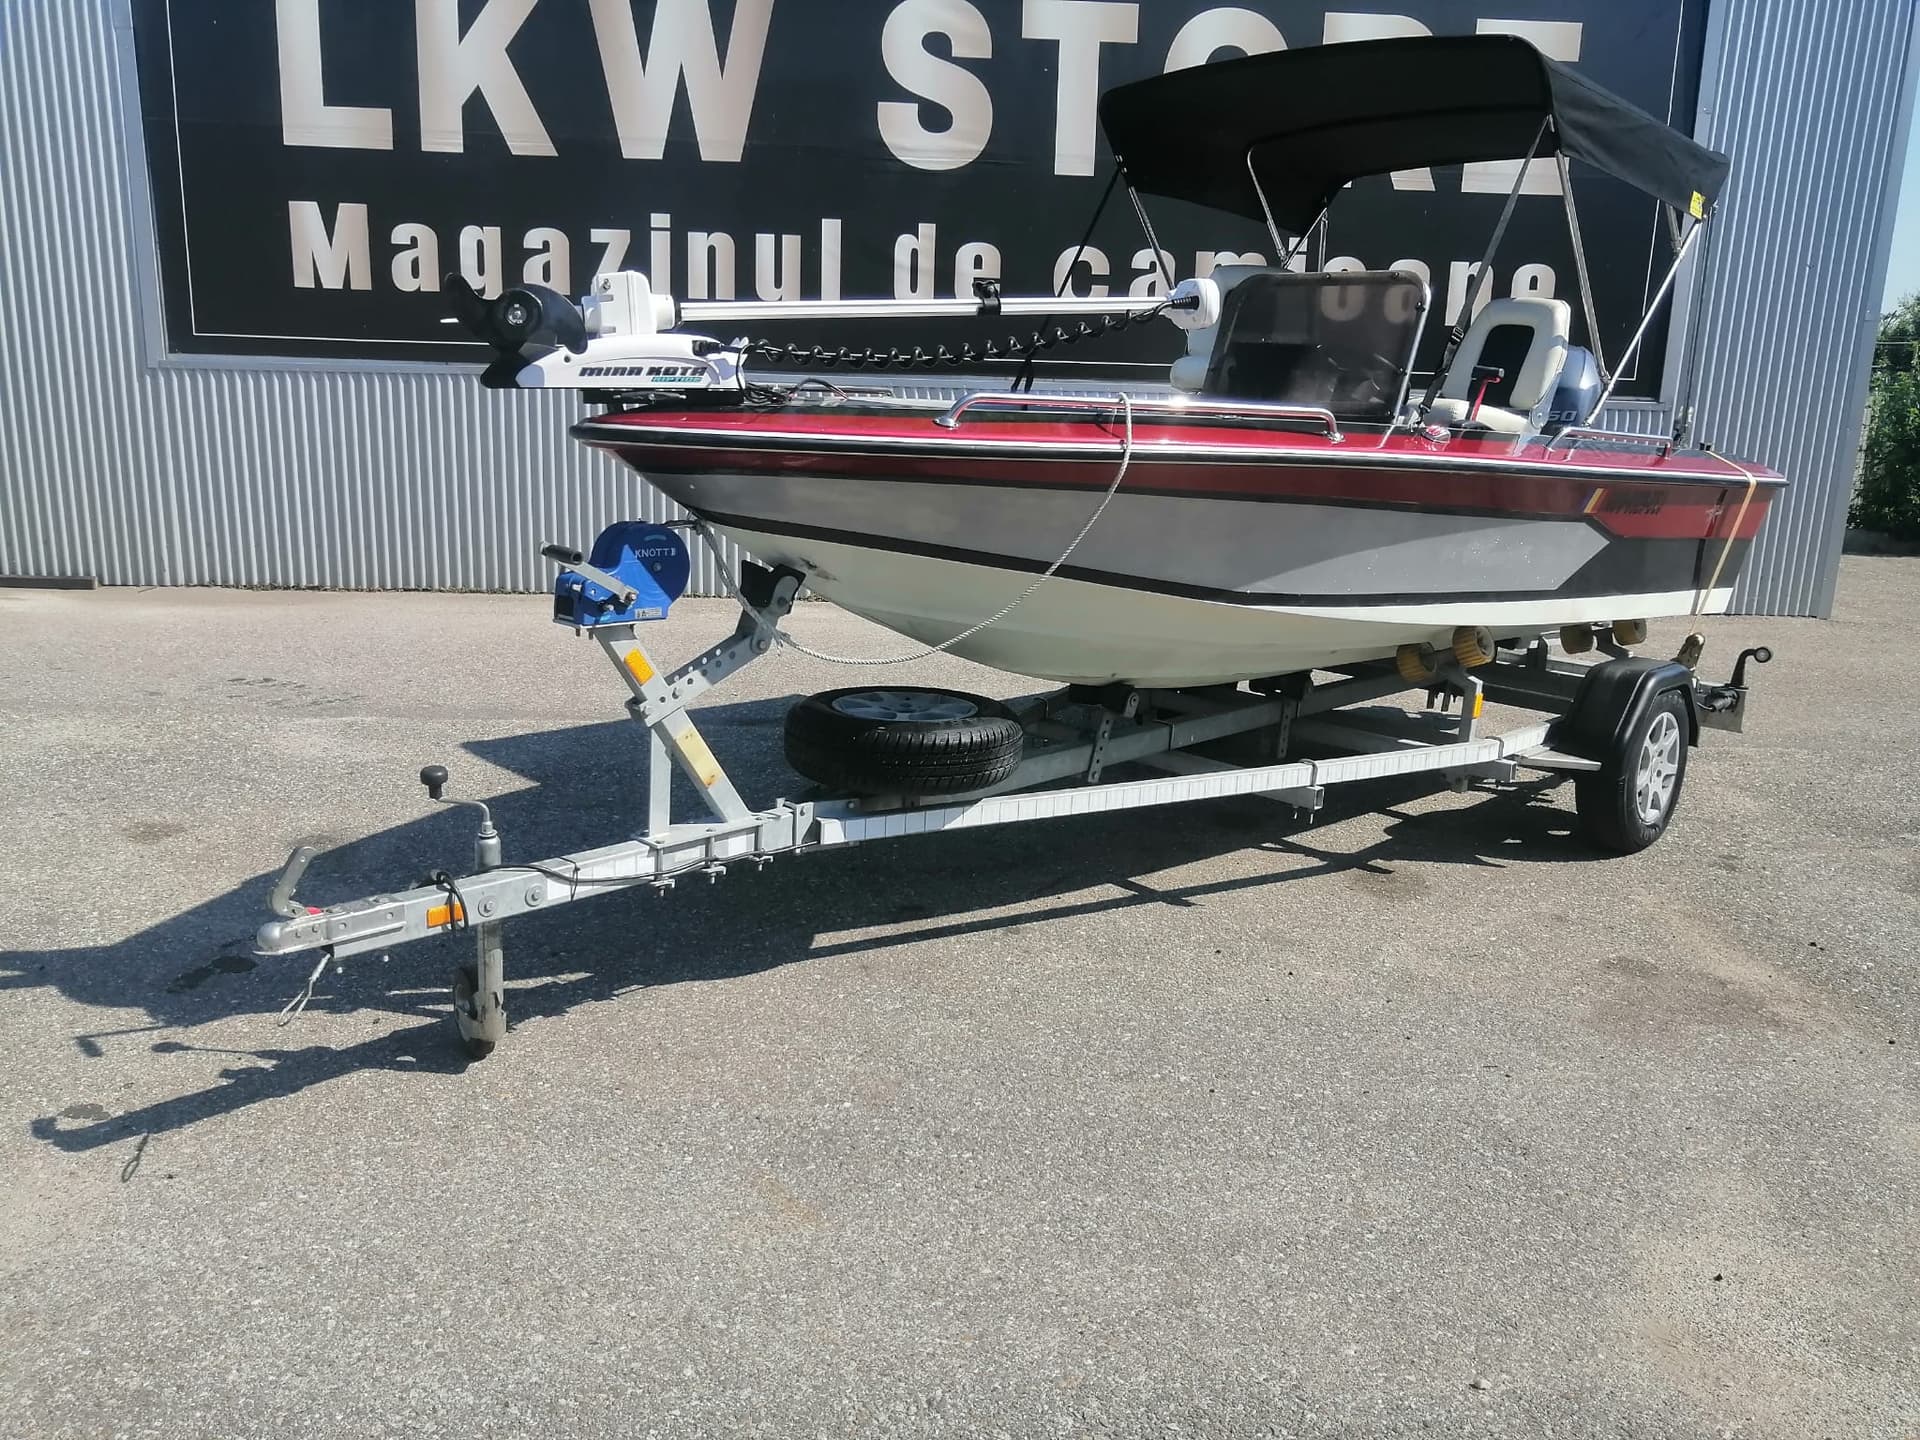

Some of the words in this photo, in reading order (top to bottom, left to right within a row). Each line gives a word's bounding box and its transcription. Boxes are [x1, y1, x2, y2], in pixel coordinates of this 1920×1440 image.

[276, 0, 773, 162] LKW
[288, 200, 842, 300] Magazinul
[894, 223, 1001, 300] de
[634, 547, 670, 559] KNOTT
